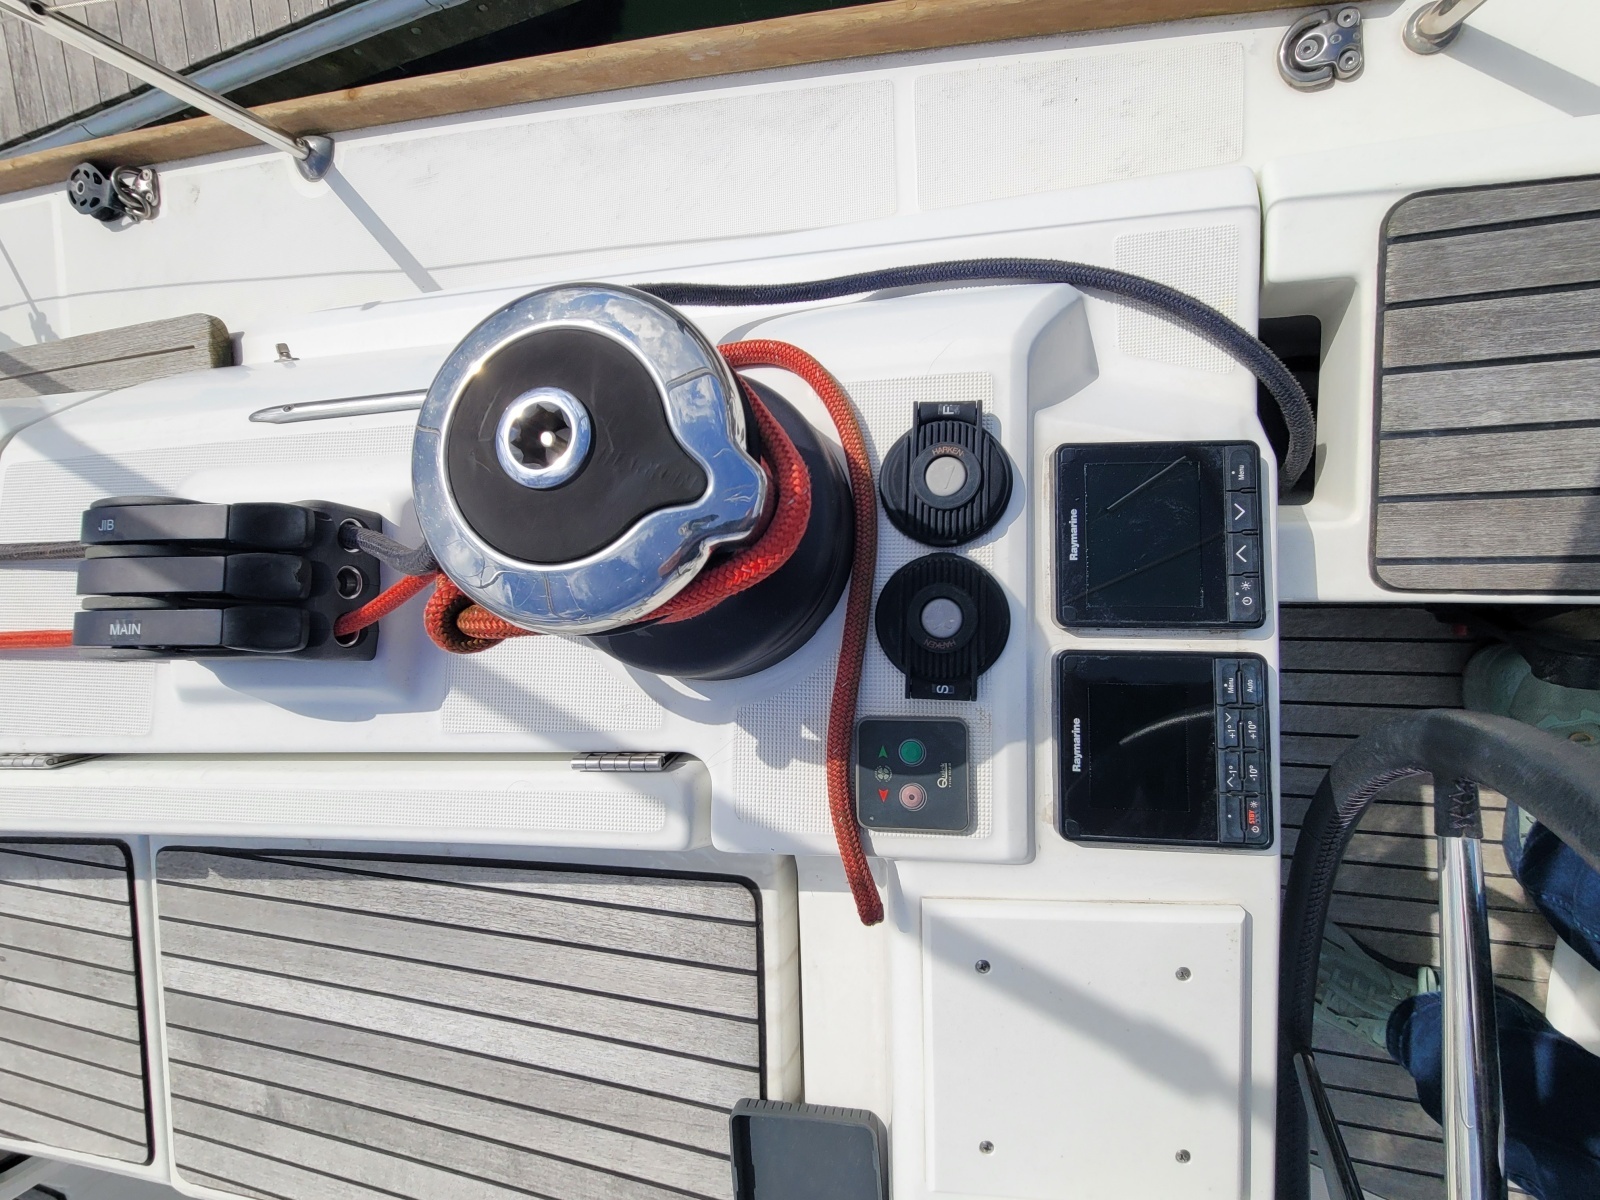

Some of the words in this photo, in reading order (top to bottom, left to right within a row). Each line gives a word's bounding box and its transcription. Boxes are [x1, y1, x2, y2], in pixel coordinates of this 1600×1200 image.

[931, 446, 965, 456] HARKEN
[98, 519, 115, 531] JIB
[1068, 508, 1080, 561] Raymarine
[109, 623, 142, 635] MAIN
[923, 639, 957, 649] HARKEN
[1227, 677, 1235, 694] Menu
[1246, 679, 1254, 693] Auto
[1071, 717, 1083, 772] Raymarine
